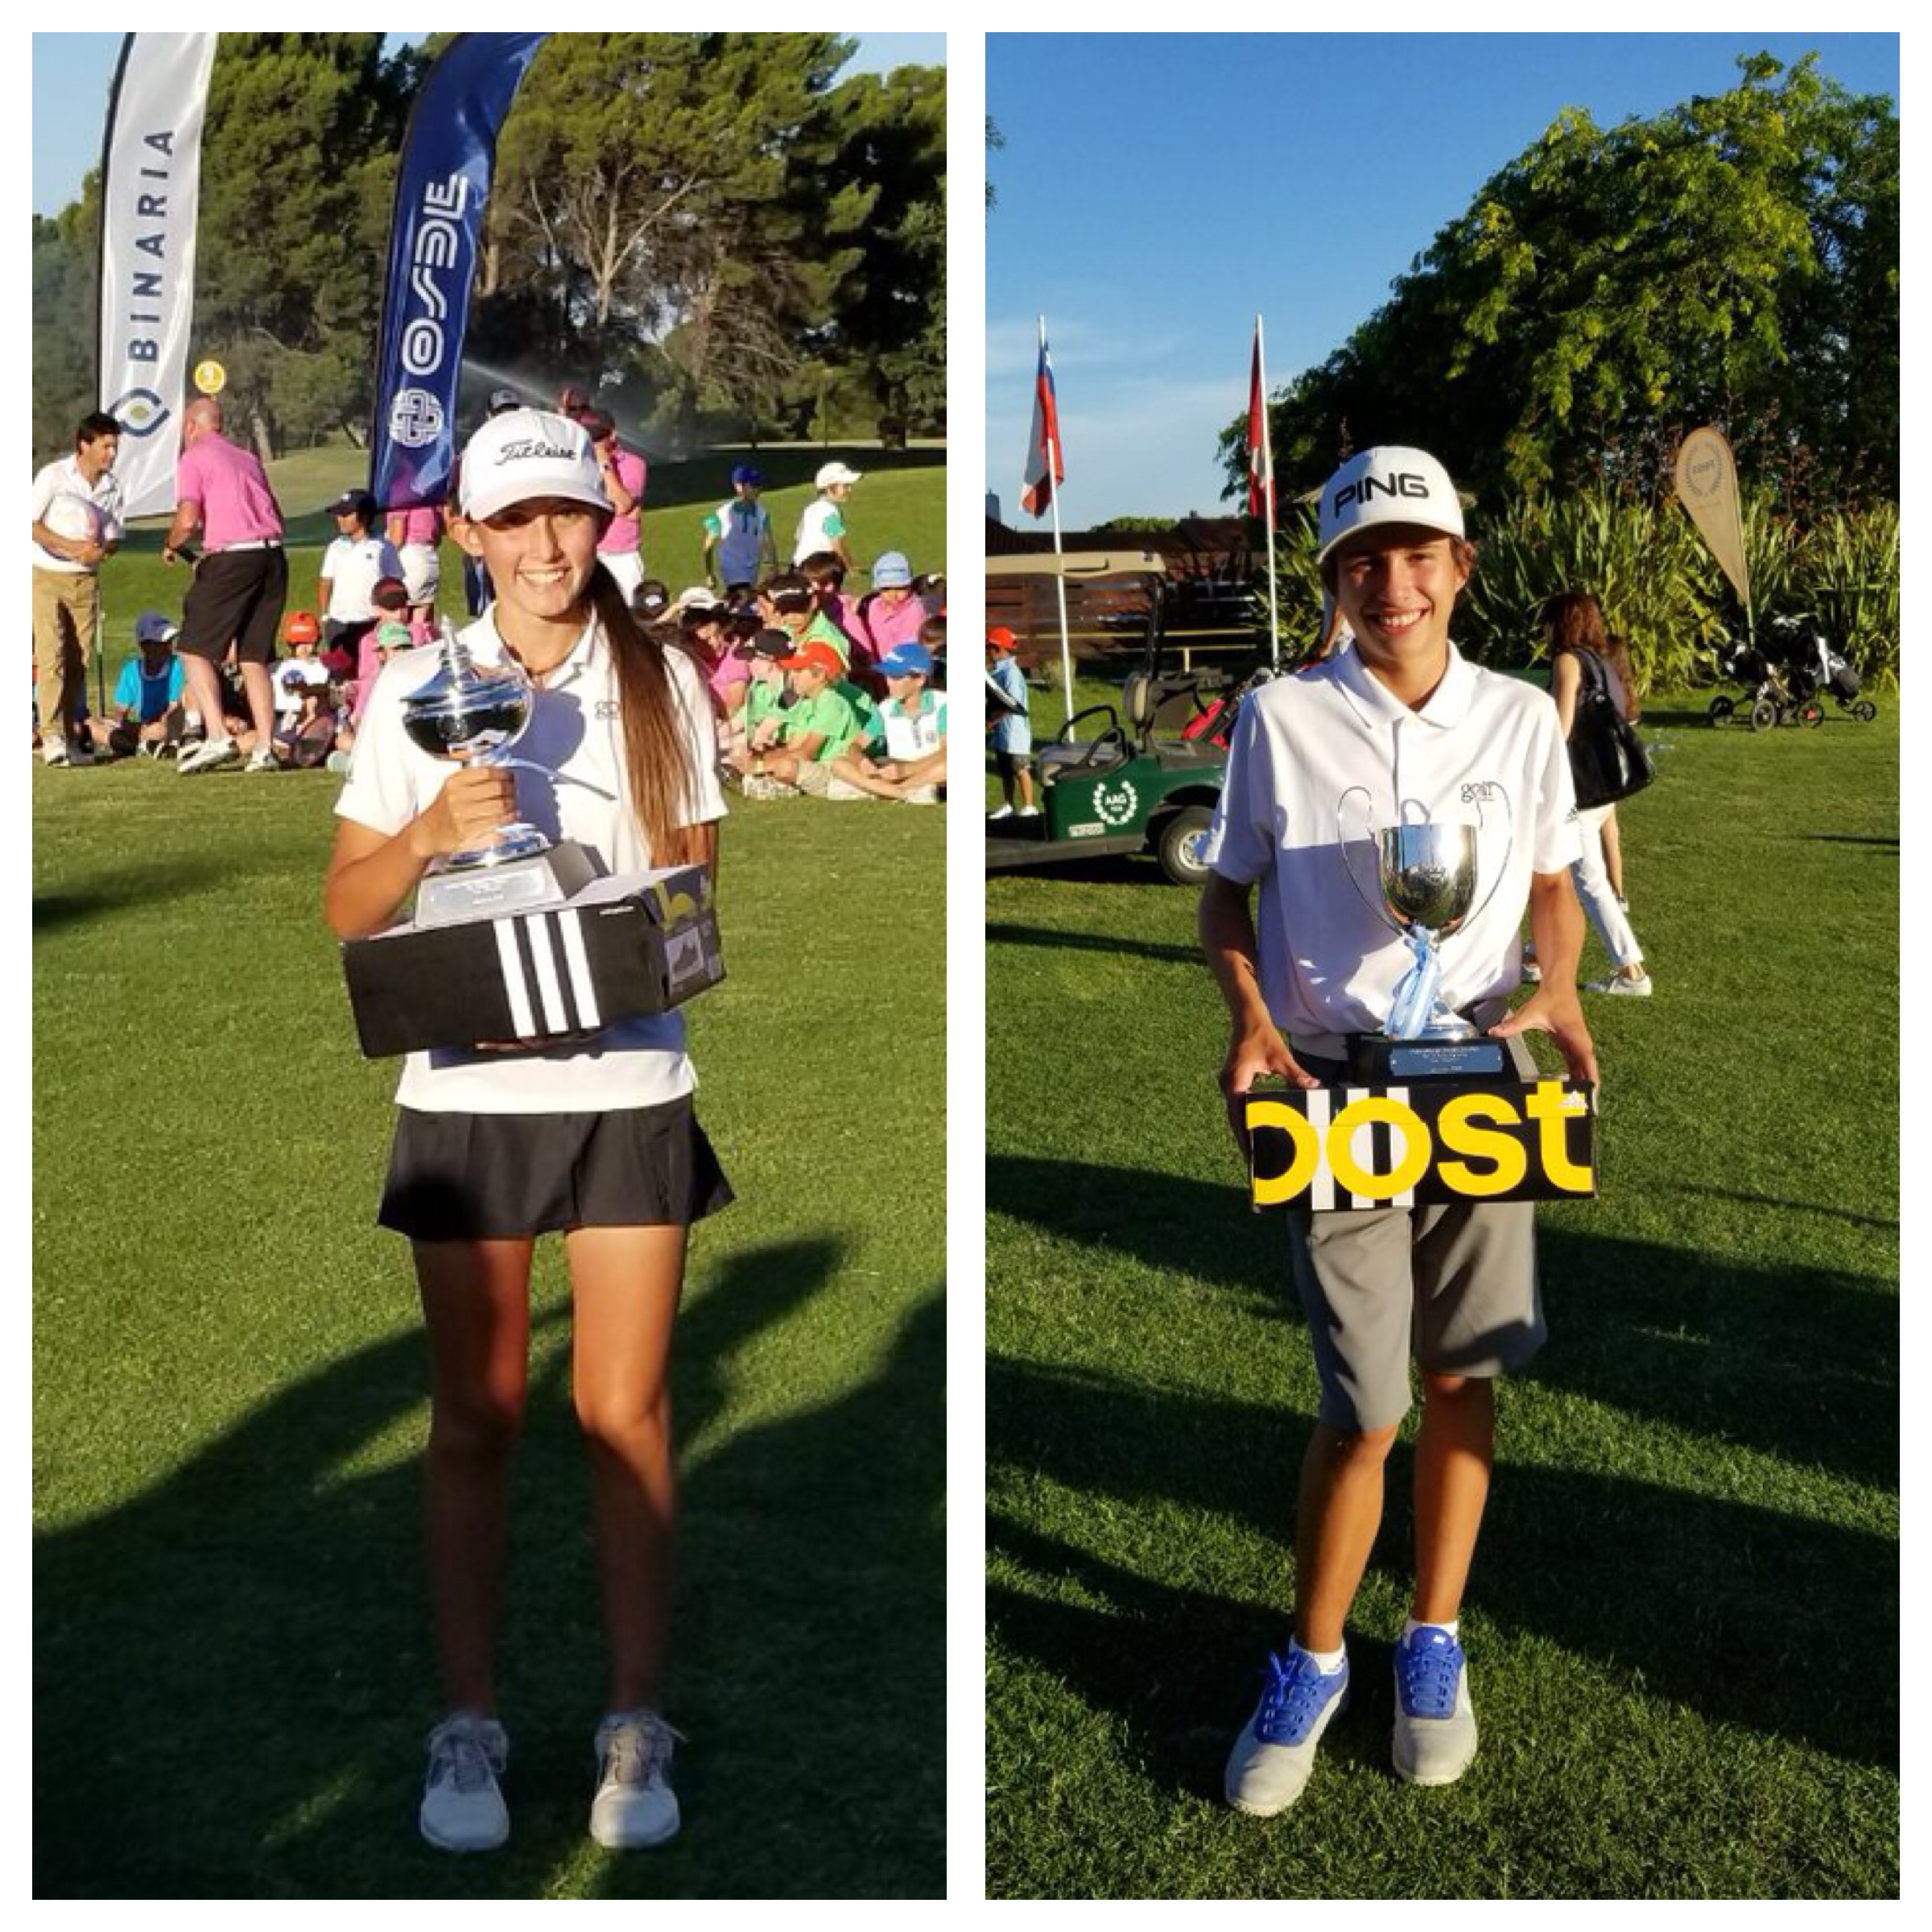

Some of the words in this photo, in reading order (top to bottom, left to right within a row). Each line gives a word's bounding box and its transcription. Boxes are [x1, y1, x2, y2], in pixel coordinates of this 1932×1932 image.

[128, 130, 174, 362] BINARIA
[402, 174, 469, 376] OSDE
[1334, 473, 1430, 519] PING
